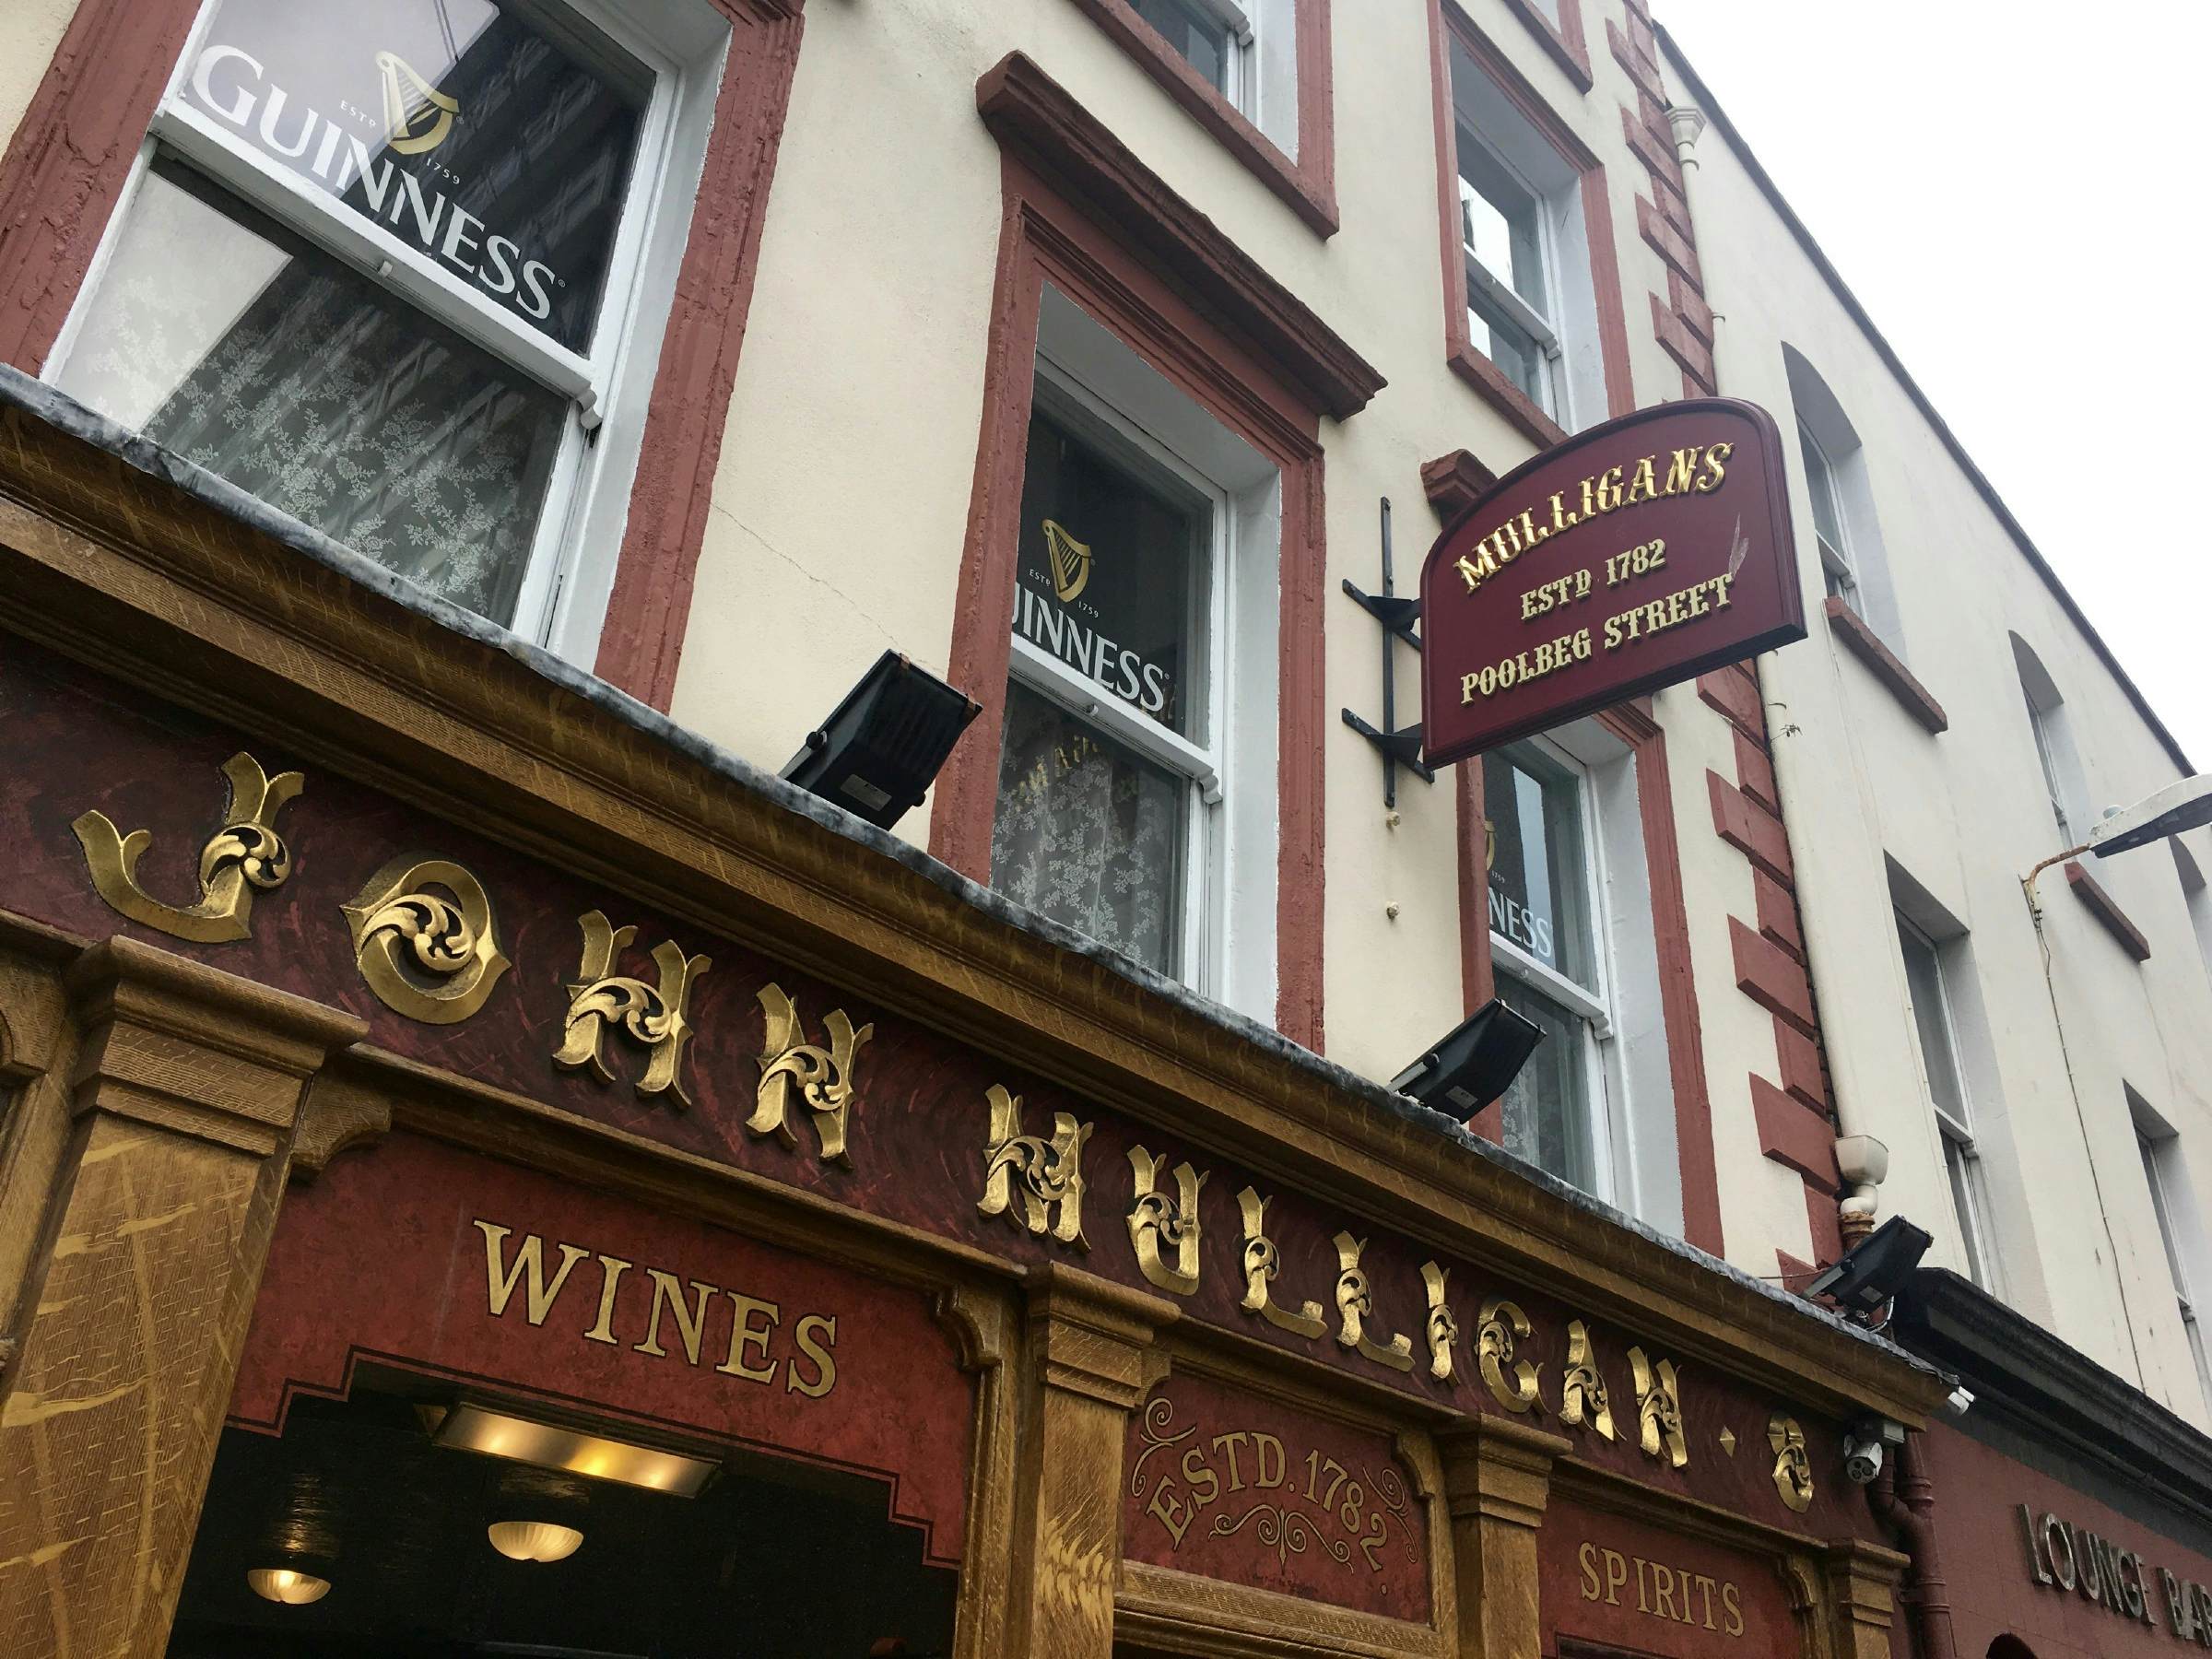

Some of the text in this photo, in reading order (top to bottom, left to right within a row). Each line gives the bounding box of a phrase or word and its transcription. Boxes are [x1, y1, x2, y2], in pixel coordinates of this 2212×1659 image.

[192, 44, 556, 320] GUINNESS
[427, 158, 460, 184] 1759
[1453, 442, 1735, 595] MULLIGANS
[1520, 538, 1668, 622] ESTD 1782
[1011, 582, 1164, 712] INNESS
[1077, 600, 1100, 618] 1759
[1460, 572, 1735, 707] POOLBEG STREET
[473, 1219, 839, 1398] WINES
[976, 1083, 1688, 1468] MULLIGAN
[1579, 1542, 1745, 1637] SPIRITS
[2017, 1503, 2159, 1626] LOUNGE
